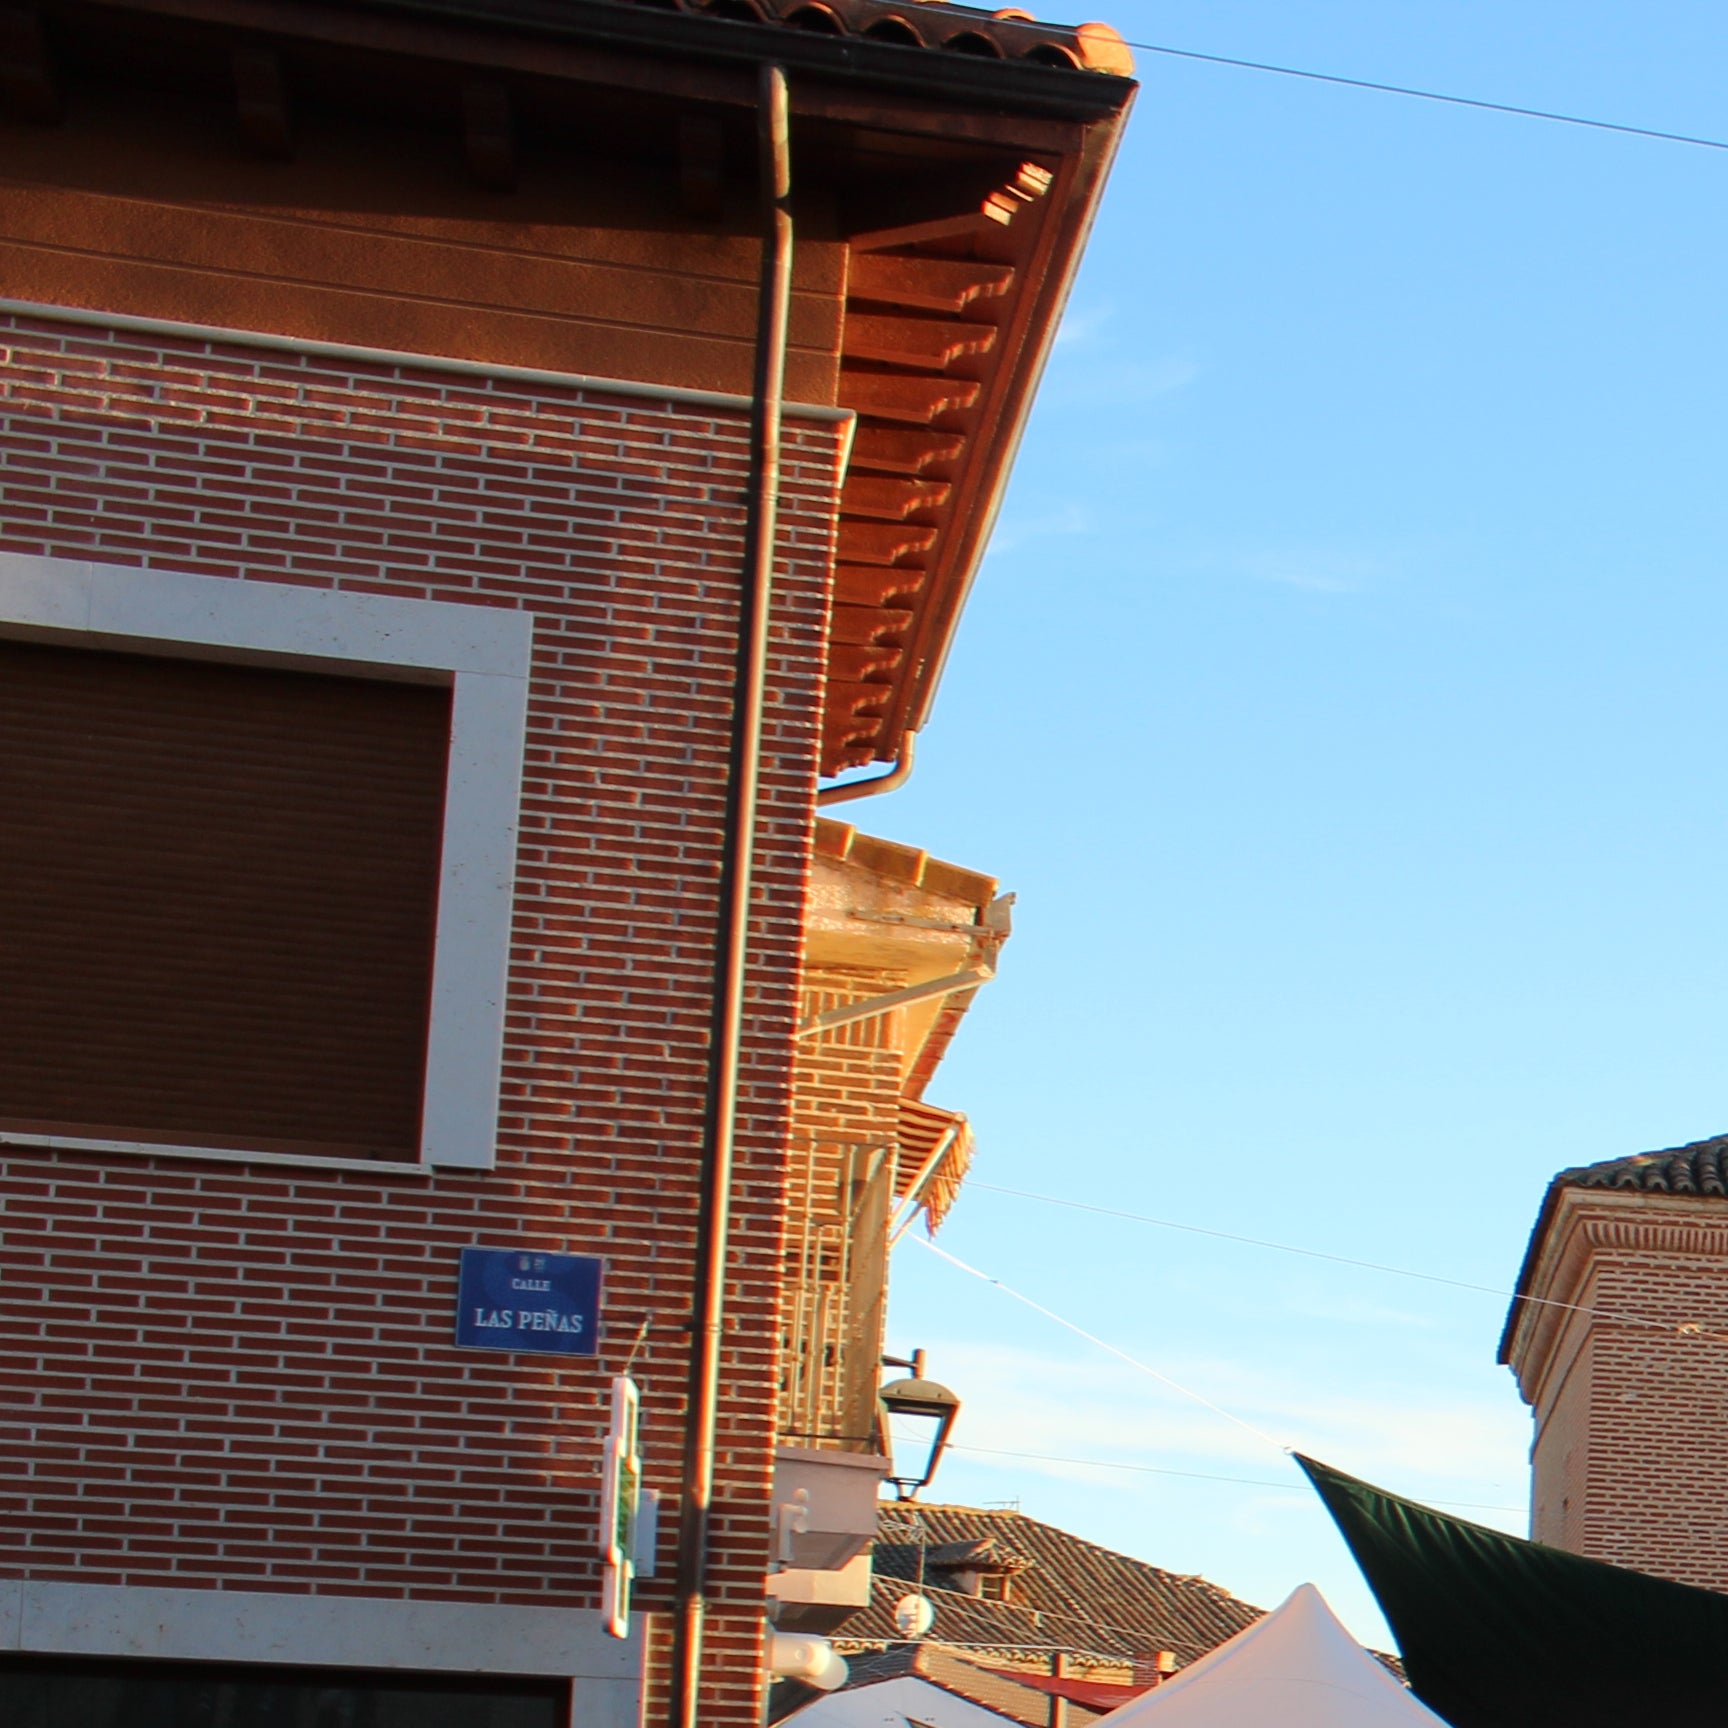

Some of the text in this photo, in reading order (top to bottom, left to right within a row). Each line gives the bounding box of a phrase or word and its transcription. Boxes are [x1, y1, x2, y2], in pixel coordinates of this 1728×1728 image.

[511, 1278, 552, 1292] CALLE
[474, 1308, 584, 1333] LAS PEÑAS
